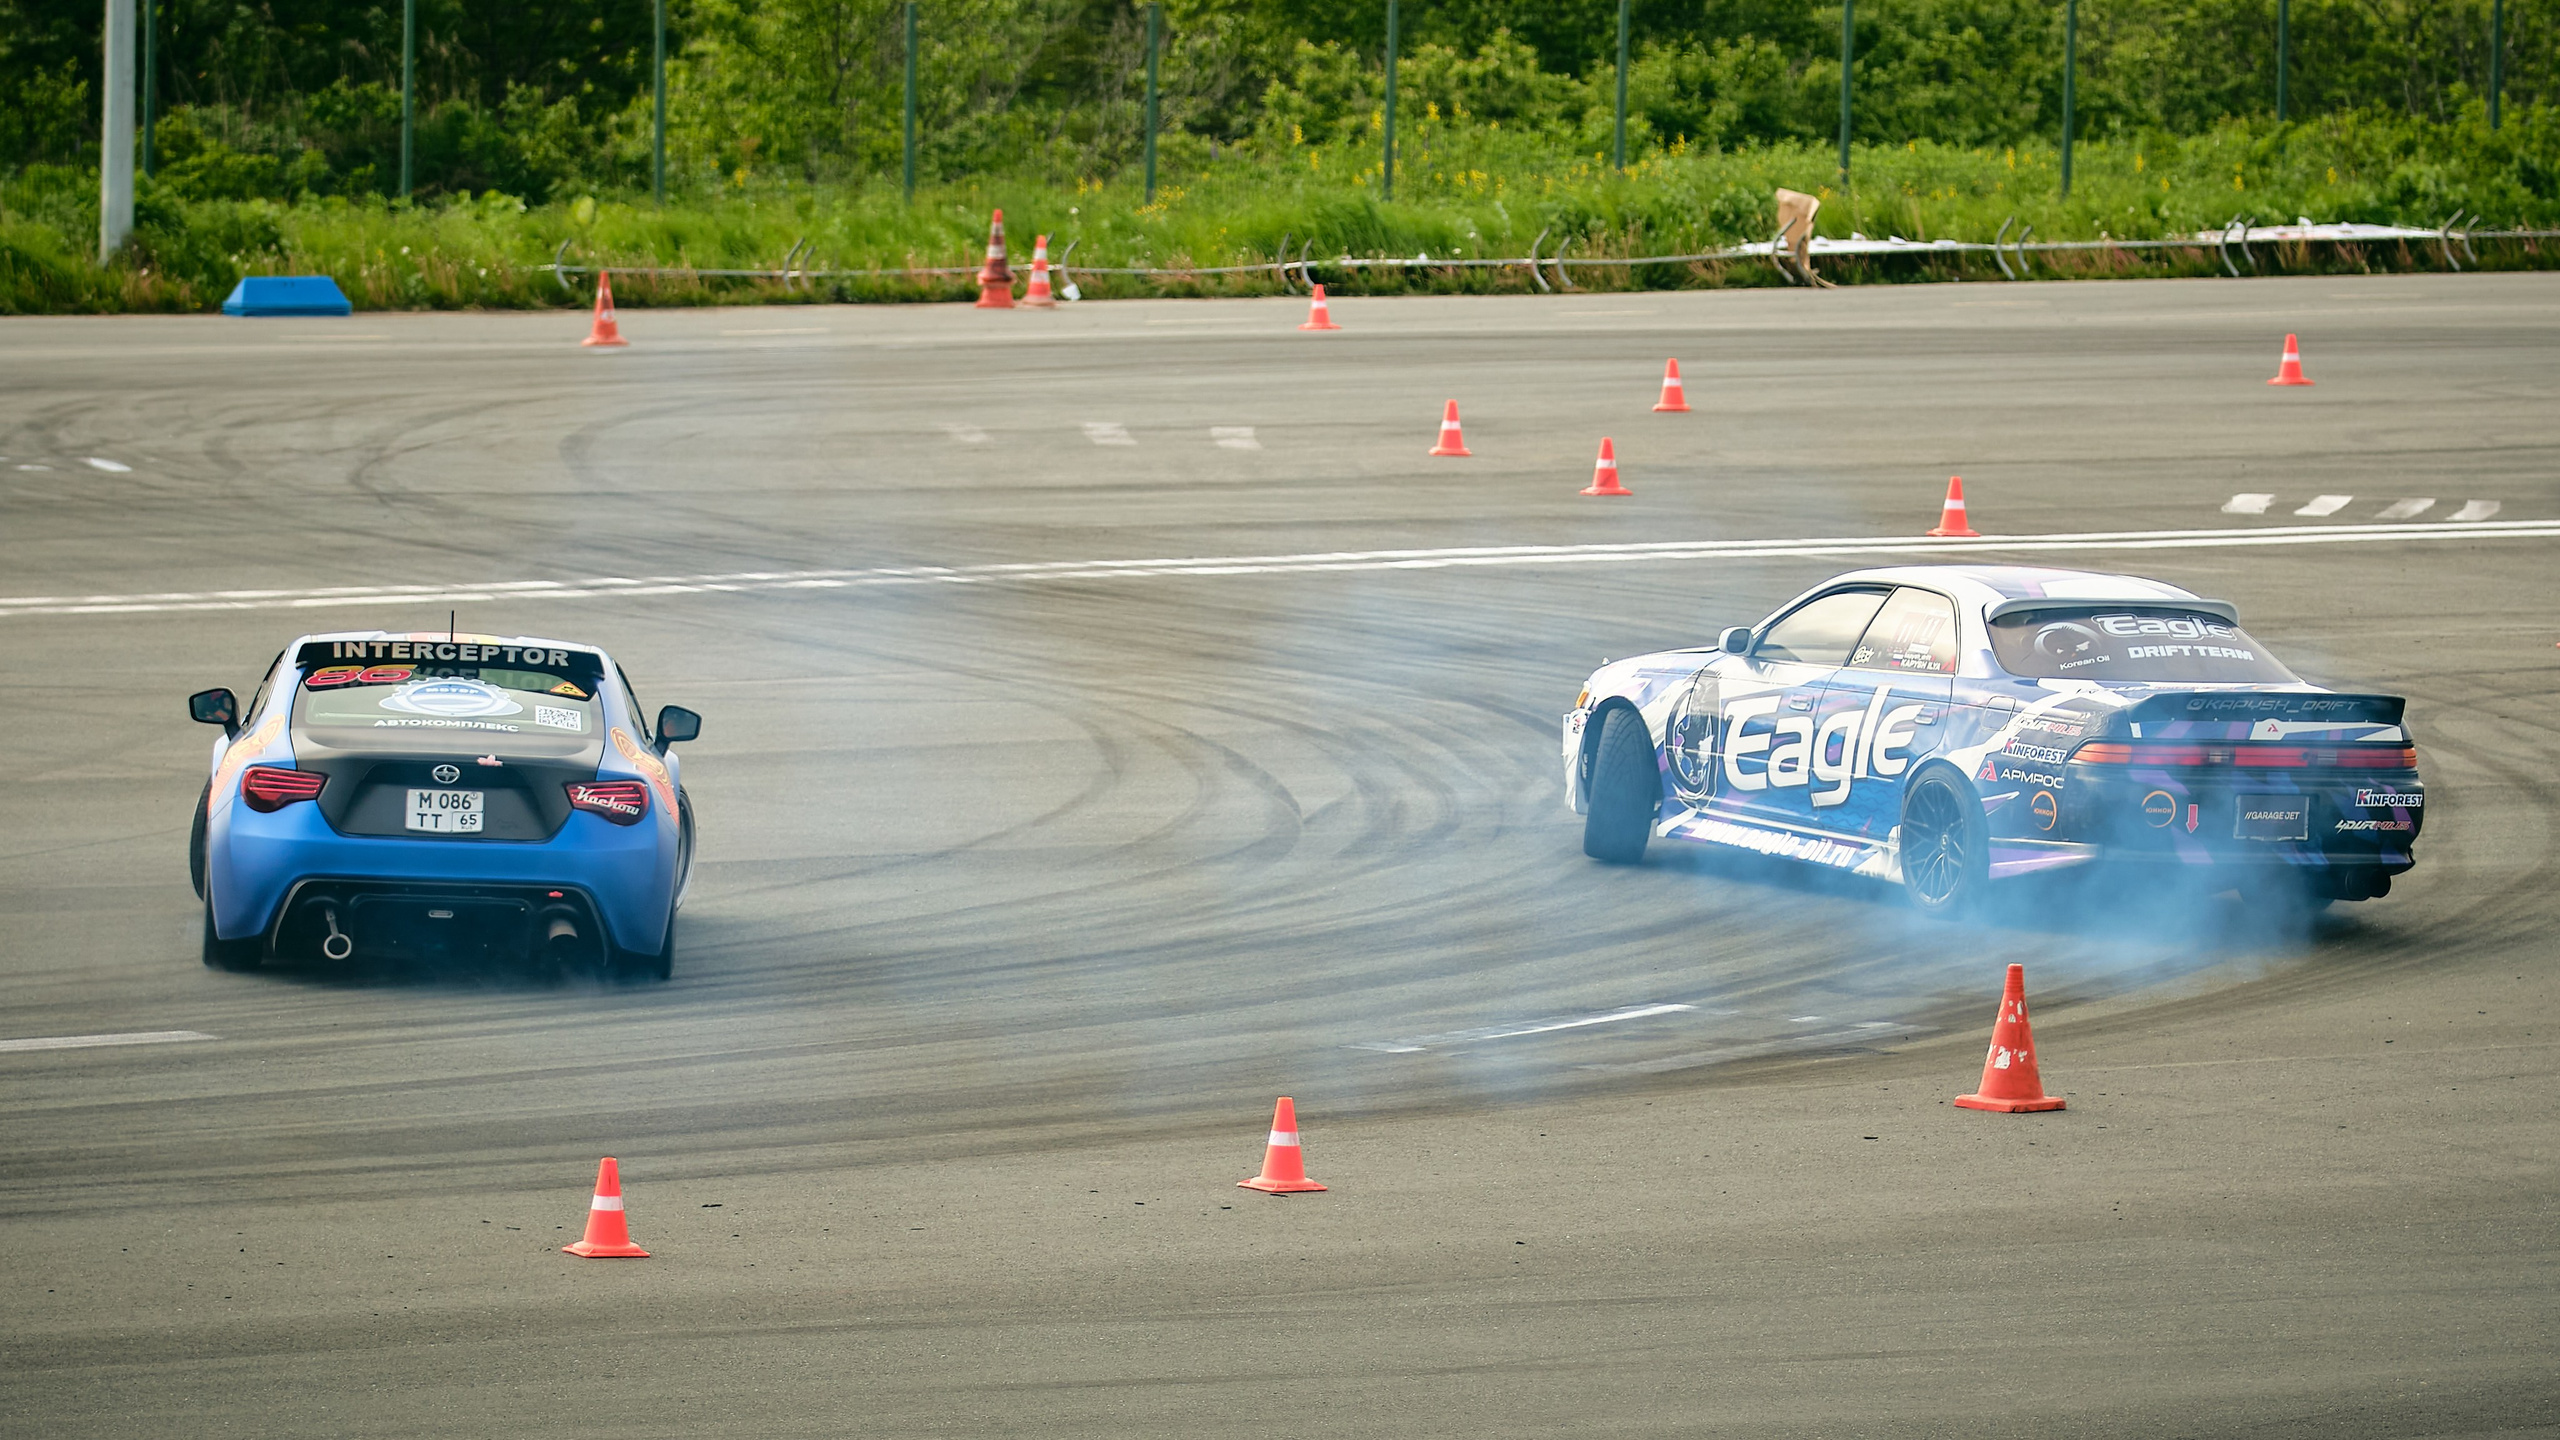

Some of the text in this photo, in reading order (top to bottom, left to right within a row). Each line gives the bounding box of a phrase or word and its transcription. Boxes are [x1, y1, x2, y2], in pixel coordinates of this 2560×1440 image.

[2092, 613, 2238, 641] Eagle
[332, 641, 570, 667] INTERCEPTOR
[2127, 645, 2255, 661] DRIFT TEAM
[2060, 654, 2110, 671] Korean Oil
[305, 664, 416, 686] 86
[425, 686, 480, 695] МОТОР
[373, 718, 520, 733] АВТОКОМПЛЕКС
[1724, 684, 1925, 808] Eagle
[2001, 736, 2068, 765] KINFOREST
[438, 793, 472, 810] 086
[2355, 788, 2424, 807] KINFOREST
[460, 814, 478, 826] 65
[2284, 811, 2300, 820] JET
[1692, 818, 1857, 868] www.eagle-oil.ru
